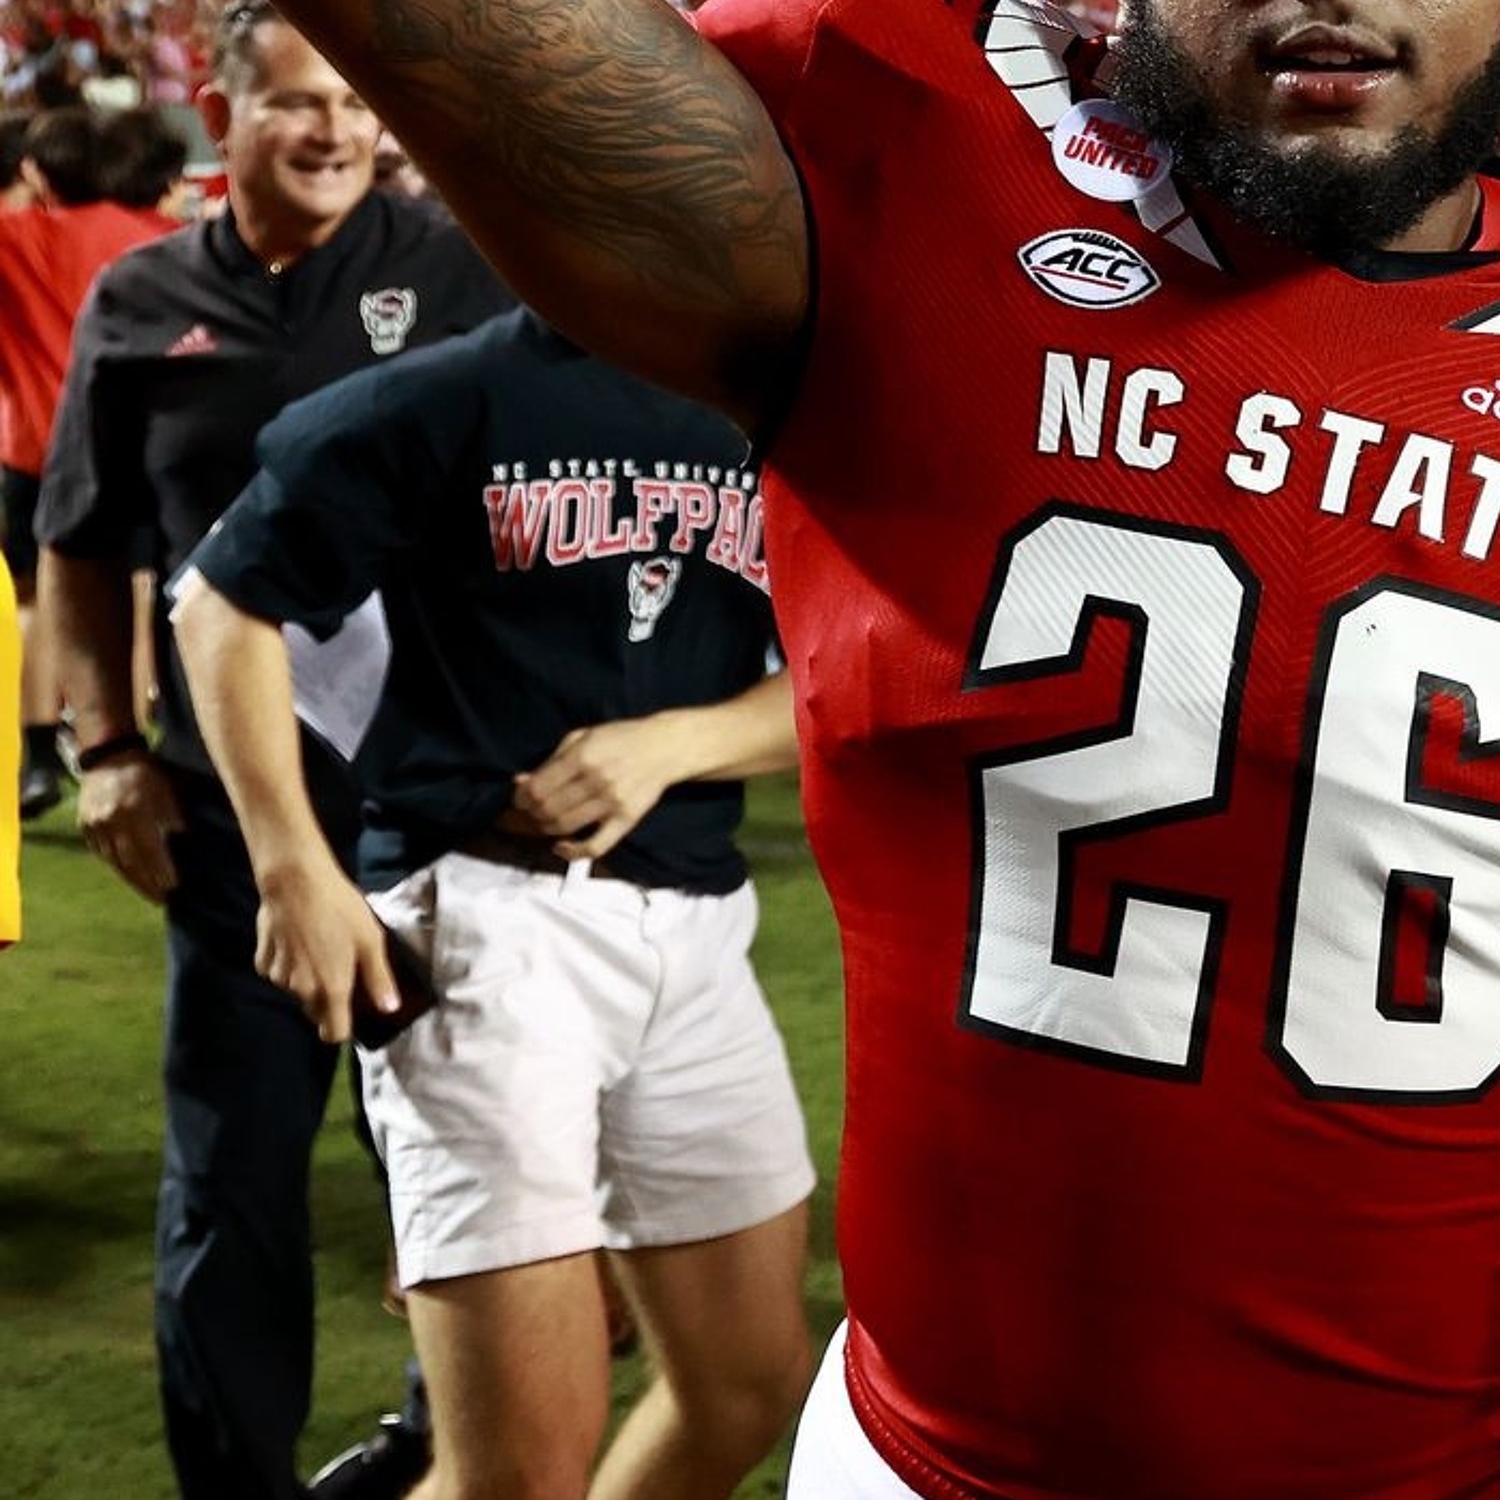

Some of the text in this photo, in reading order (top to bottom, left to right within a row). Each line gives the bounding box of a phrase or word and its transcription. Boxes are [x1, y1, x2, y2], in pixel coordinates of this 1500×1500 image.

[1064, 135, 1159, 181] UNITED
[1041, 248, 1140, 284] ACC
[1037, 351, 1184, 471] NC
